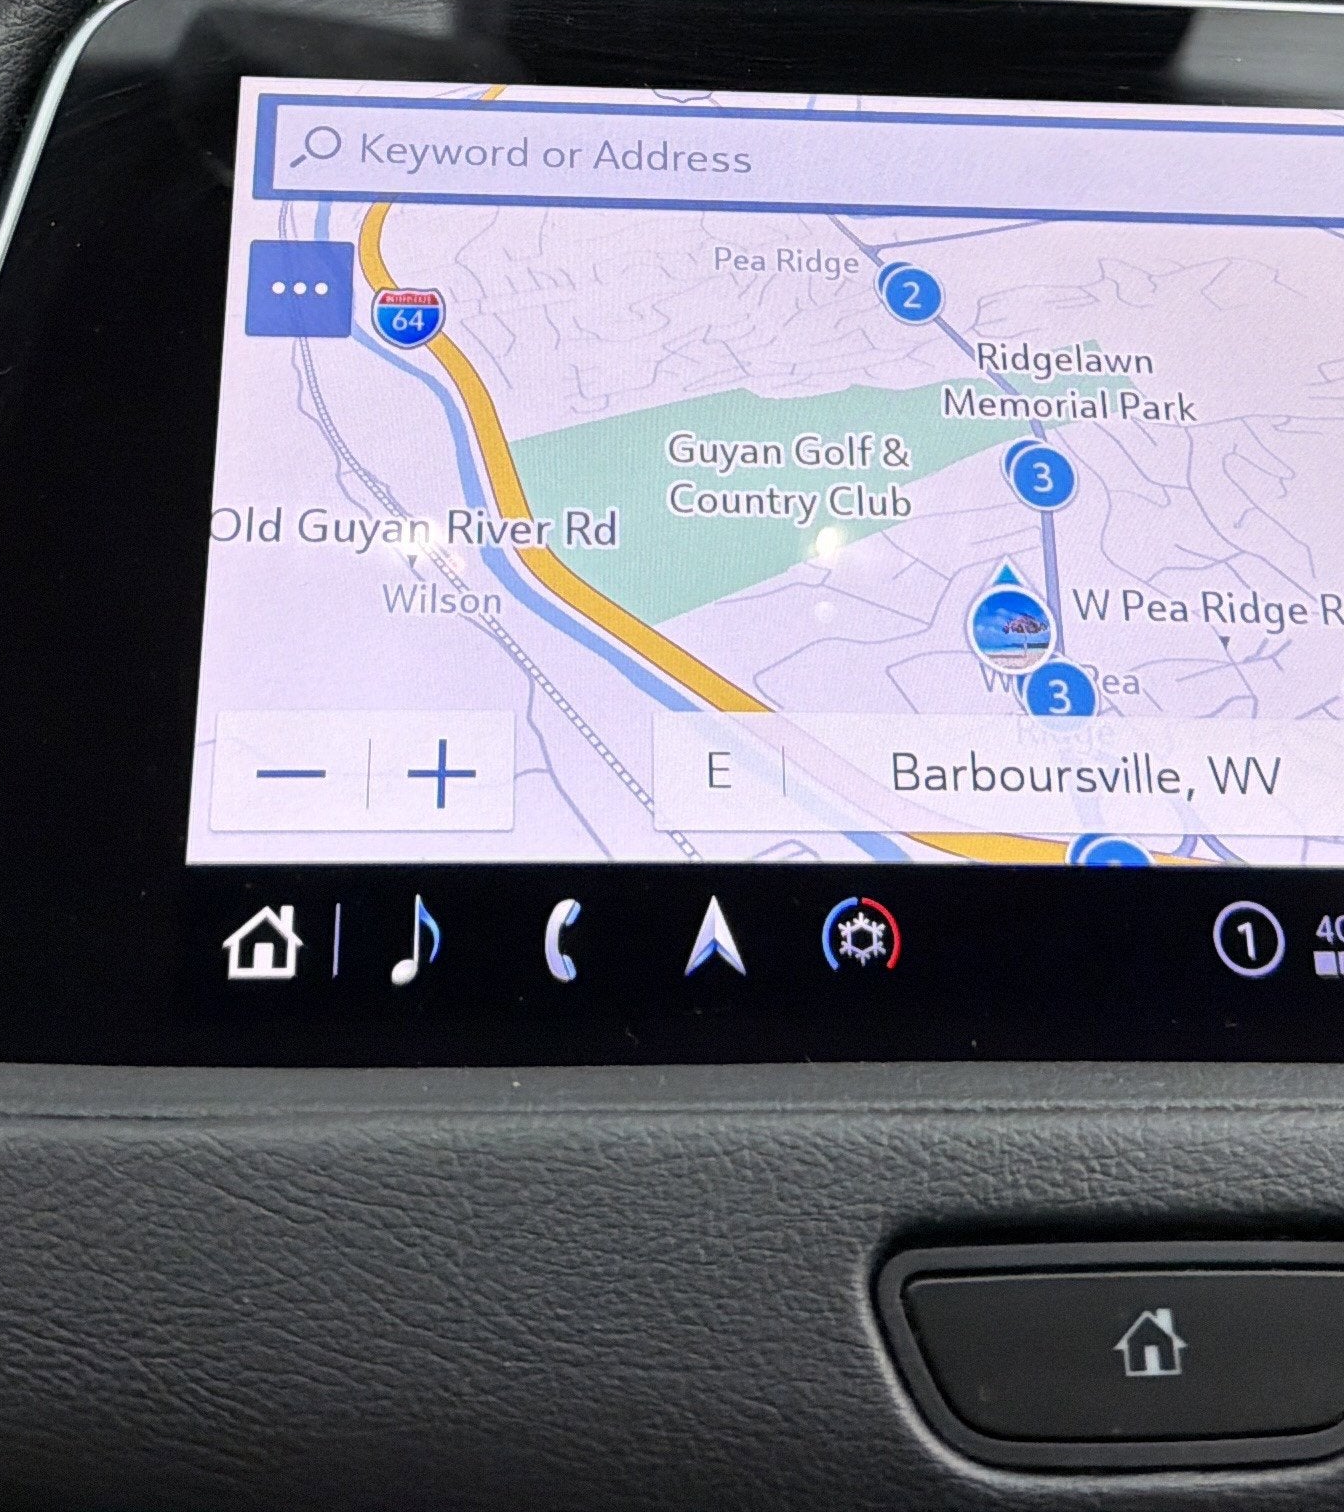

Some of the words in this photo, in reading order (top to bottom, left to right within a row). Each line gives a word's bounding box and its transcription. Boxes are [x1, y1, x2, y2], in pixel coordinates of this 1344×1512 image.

[362, 133, 528, 175] Keyword
[543, 144, 581, 169] or
[594, 142, 752, 174] Address
[714, 247, 766, 272] Pea
[777, 248, 859, 279] Ridge
[903, 281, 921, 308] 2
[392, 309, 425, 332] 64
[977, 343, 1154, 381] Ridgelawn
[944, 390, 1109, 420] Memorial
[1120, 393, 1197, 421] Park
[668, 434, 782, 473] Guyan
[795, 436, 872, 467] Golf
[884, 440, 910, 467] &
[1034, 463, 1053, 492] 3
[670, 485, 817, 523] Country
[829, 487, 912, 517] Club
[209, 507, 281, 543] Old
[298, 510, 429, 554] Guyan
[447, 510, 550, 546] River
[567, 512, 617, 547] Rd
[384, 584, 501, 614] Wilson
[1073, 590, 1109, 620] W
[1123, 590, 1189, 623] Pea
[1202, 592, 1309, 634] Ridge
[1049, 679, 1071, 714] 3
[707, 752, 731, 788] E
[892, 752, 1194, 801] Barboursville,
[1208, 756, 1281, 795] WV
[1238, 921, 1256, 960] 1
